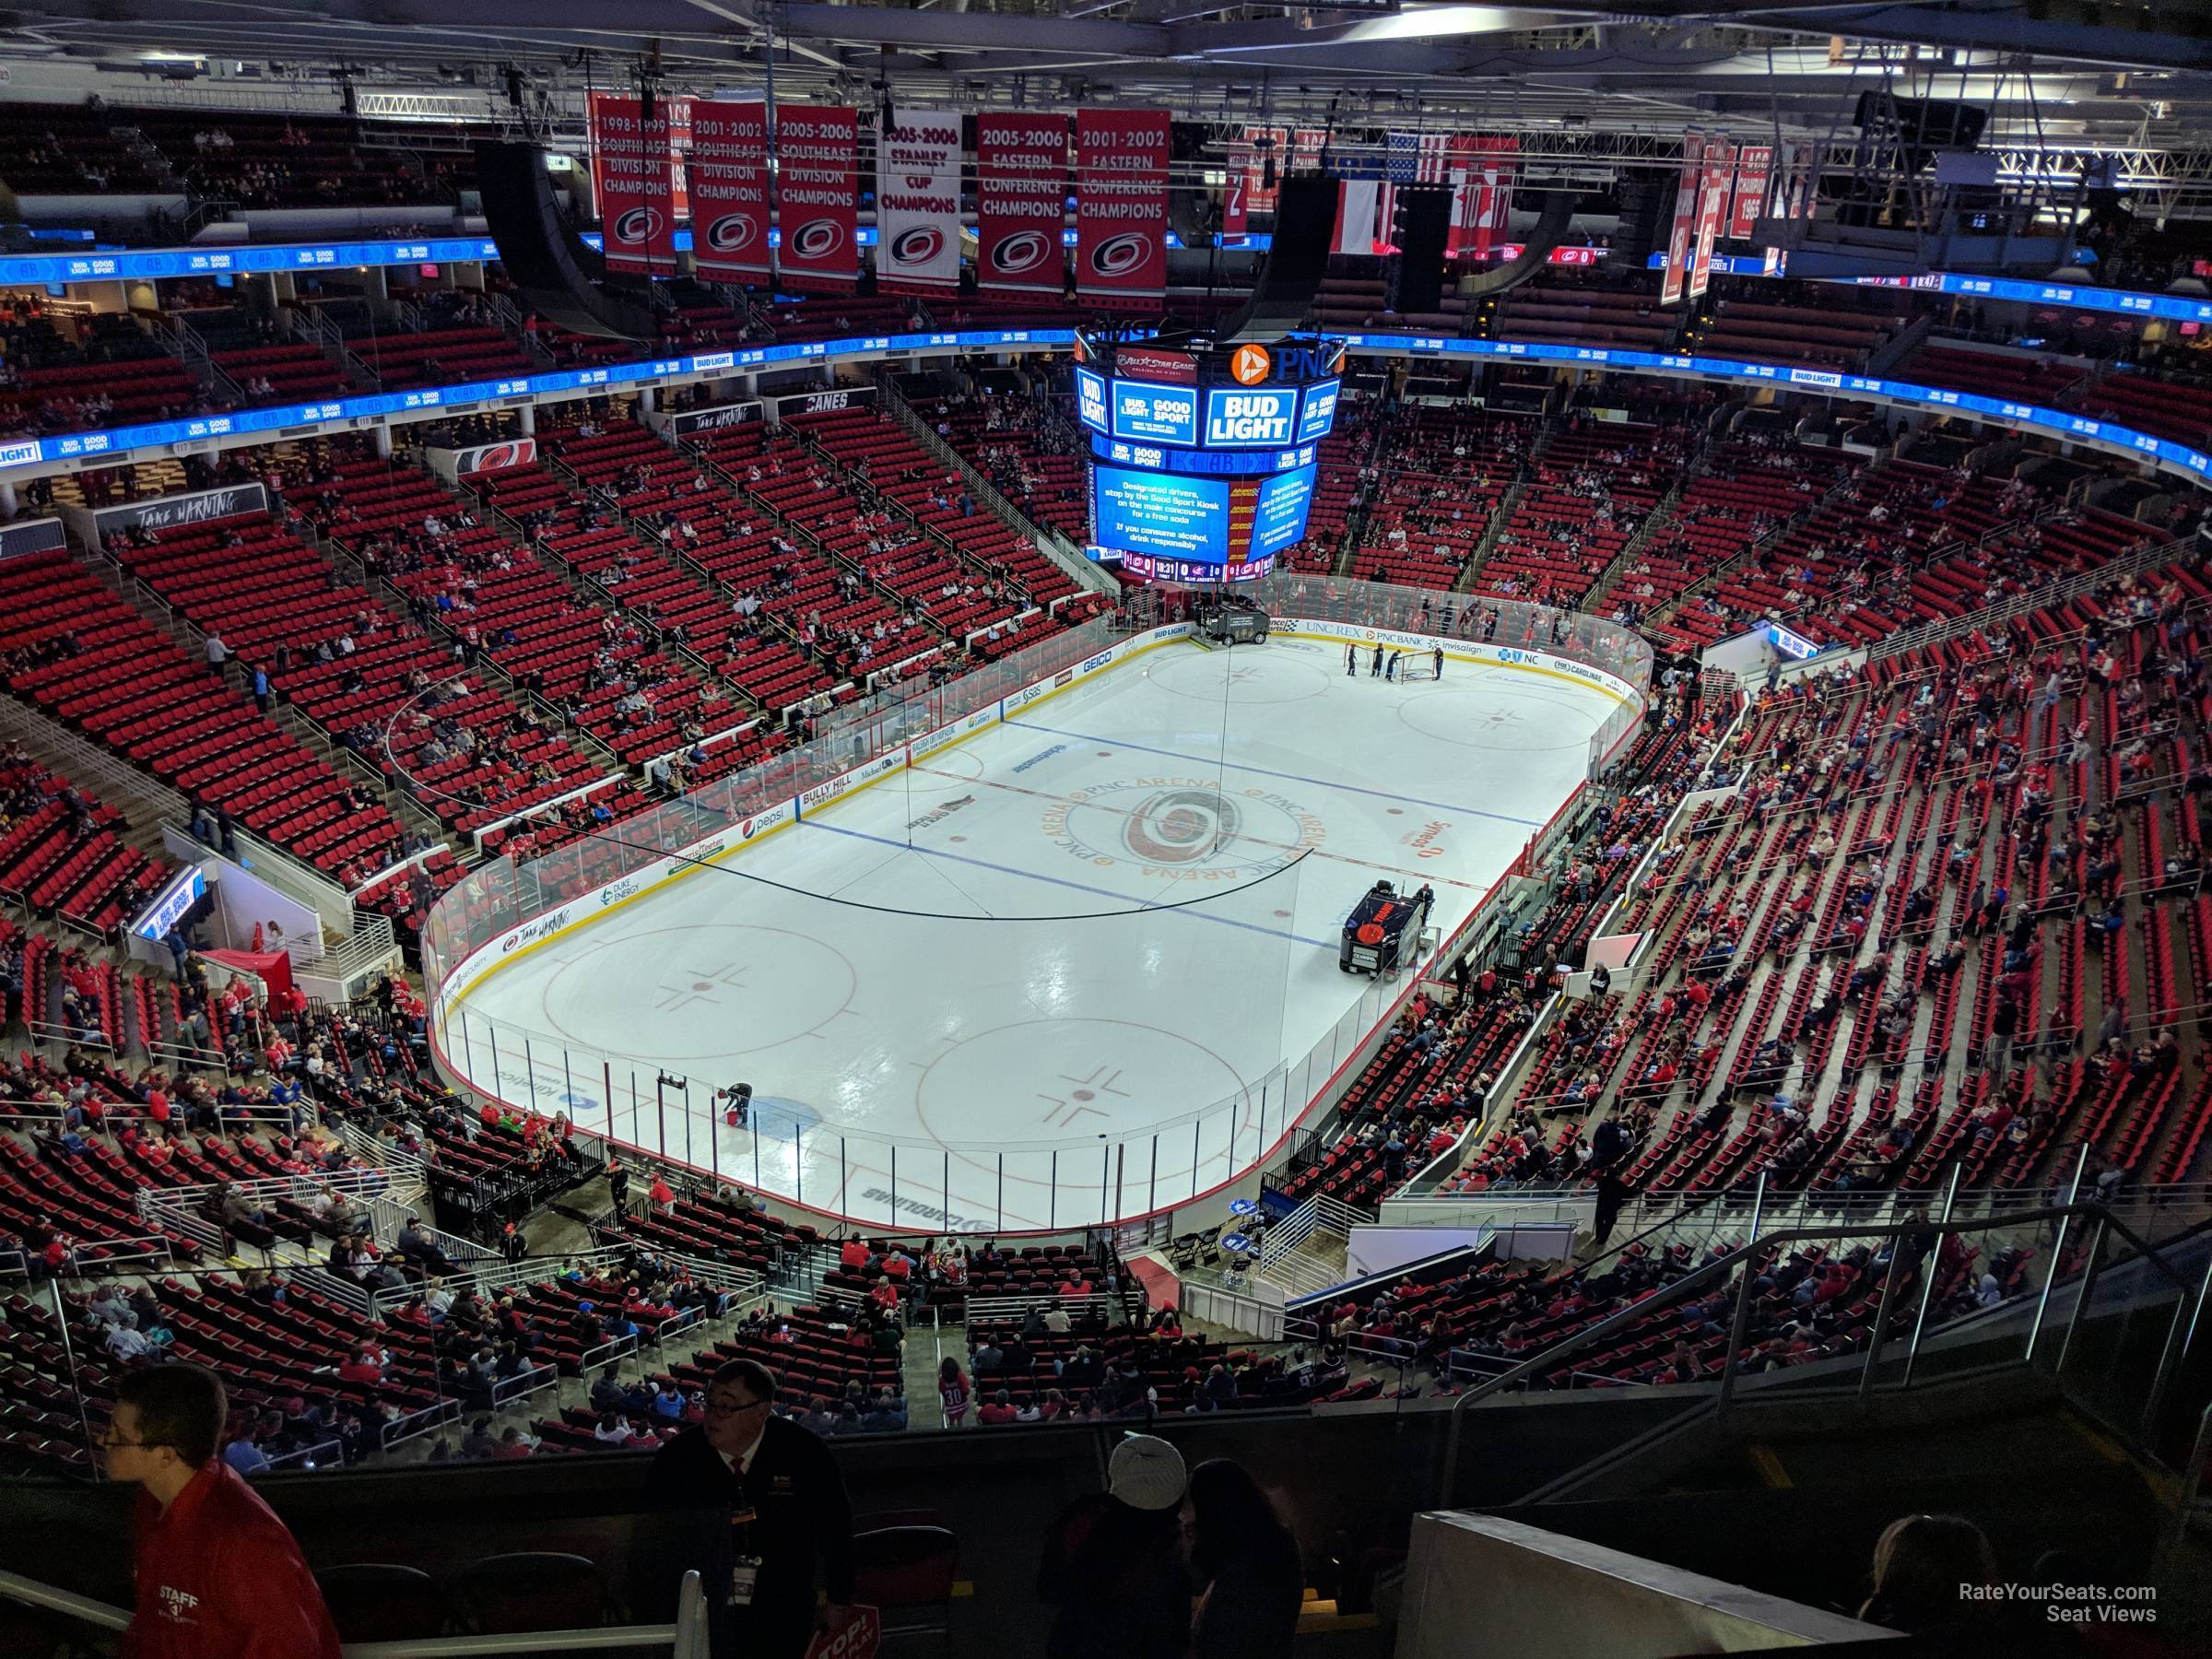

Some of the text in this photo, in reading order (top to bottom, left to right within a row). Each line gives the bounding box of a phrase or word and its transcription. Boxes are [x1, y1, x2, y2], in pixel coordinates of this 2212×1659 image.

[696, 121, 761, 137] 2001-2002
[782, 122, 853, 140] 2005-2006
[982, 129, 1062, 146] 2005-2006
[1083, 130, 1165, 147] 2001-2002
[603, 139, 666, 155] SOUTHAST
[696, 142, 760, 159] SOUTHEAST
[782, 144, 853, 162] SOUTHEAST
[891, 149, 947, 167] STANLEY
[993, 154, 1052, 169] EASTERN
[1092, 155, 1153, 169] EASTERN
[704, 164, 755, 180] DIVISION
[790, 169, 844, 184] DIVISION
[906, 177, 932, 189] CUP
[982, 178, 1060, 194] CONFERENCE
[1082, 179, 1163, 195] CONFERENCE
[697, 184, 763, 202] CHAMPIONS
[782, 188, 853, 206] CHAMPIONS
[882, 194, 956, 213] CHAMPIONS
[982, 200, 1060, 217] CHAMPIONS
[1081, 203, 1162, 219] CHAMPIONS
[1709, 261, 1727, 271] ACKETS
[697, 357, 730, 368] BUD LIGHT
[1127, 356, 1196, 371] ALL STAR GAME
[1277, 343, 1333, 380] PNC
[1796, 372, 1836, 384] BUD LIGHT
[1082, 377, 1101, 402] BUD
[806, 392, 849, 413] CANES
[1082, 396, 1105, 425] LIGHT
[1124, 398, 1146, 408] BUD
[1153, 400, 1191, 414] GOOD
[1224, 396, 1280, 418] BUD
[696, 407, 749, 429] TAKE WARNING
[1121, 406, 1150, 417] LIGHT
[1154, 412, 1191, 424] SPORT
[1212, 418, 1288, 439] LIGHT
[84, 435, 107, 445] GOOD
[86, 443, 107, 451] SPORT
[0, 447, 32, 461] IGHT
[1112, 451, 1130, 461] LIGHT
[1115, 444, 1128, 453] BUD
[1134, 447, 1161, 459] GOOD
[1134, 457, 1161, 467] SPORT
[1278, 459, 1296, 469] LIGHT
[1123, 482, 1199, 499] Designated drivers,
[1105, 489, 1219, 510] stop by the Good Sport Kiosk
[137, 492, 237, 528] TAKE WARNING
[1129, 500, 1141, 509] the
[1144, 503, 1163, 512] main
[1165, 506, 1206, 517] concourse
[1152, 512, 1168, 521] free
[1170, 515, 1189, 524] soda
[1125, 524, 1139, 533] you
[1141, 526, 1176, 538] consume
[1178, 531, 1208, 543] alcohol,
[1130, 534, 1196, 551] drink responsibly
[1144, 559, 1151, 570] 0
[1181, 564, 1188, 576] 0
[1154, 626, 1187, 638] BUD LIGHT
[1306, 623, 1361, 637] UNC REX
[1377, 632, 1424, 646] PNC BANK
[1442, 641, 1482, 654] invisalign
[1083, 651, 1112, 672] GEICO
[1525, 653, 1539, 664] NC
[1056, 672, 1072, 685] Lenovo
[1571, 665, 1602, 682] CAROLINAS
[912, 724, 956, 752] RALEIGH ORTHOPAEDIC
[1012, 744, 1067, 774] ticketmaster
[861, 764, 882, 780] Michael
[803, 775, 852, 805] BULLY HILL
[1083, 777, 1219, 794] PNC ARENA
[812, 787, 844, 807] VINEYARDS
[757, 807, 784, 832] pepsi
[1264, 794, 1327, 847] PNC ARENA
[1041, 804, 1098, 860] PNC ARENA
[1411, 820, 1453, 848] Syneos
[675, 849, 700, 866] Harris
[1142, 867, 1237, 880] ARENA
[613, 877, 630, 892] DUKE
[614, 883, 640, 902] ENERGY
[520, 909, 570, 941] TAKE WARNING
[1353, 952, 1377, 963] OLYMPIA
[862, 1186, 964, 1227] CAROLINAS
[945, 1389, 961, 1405] 30
[159, 1585, 199, 1608] STAFF
[818, 1614, 867, 1659] TOP!
